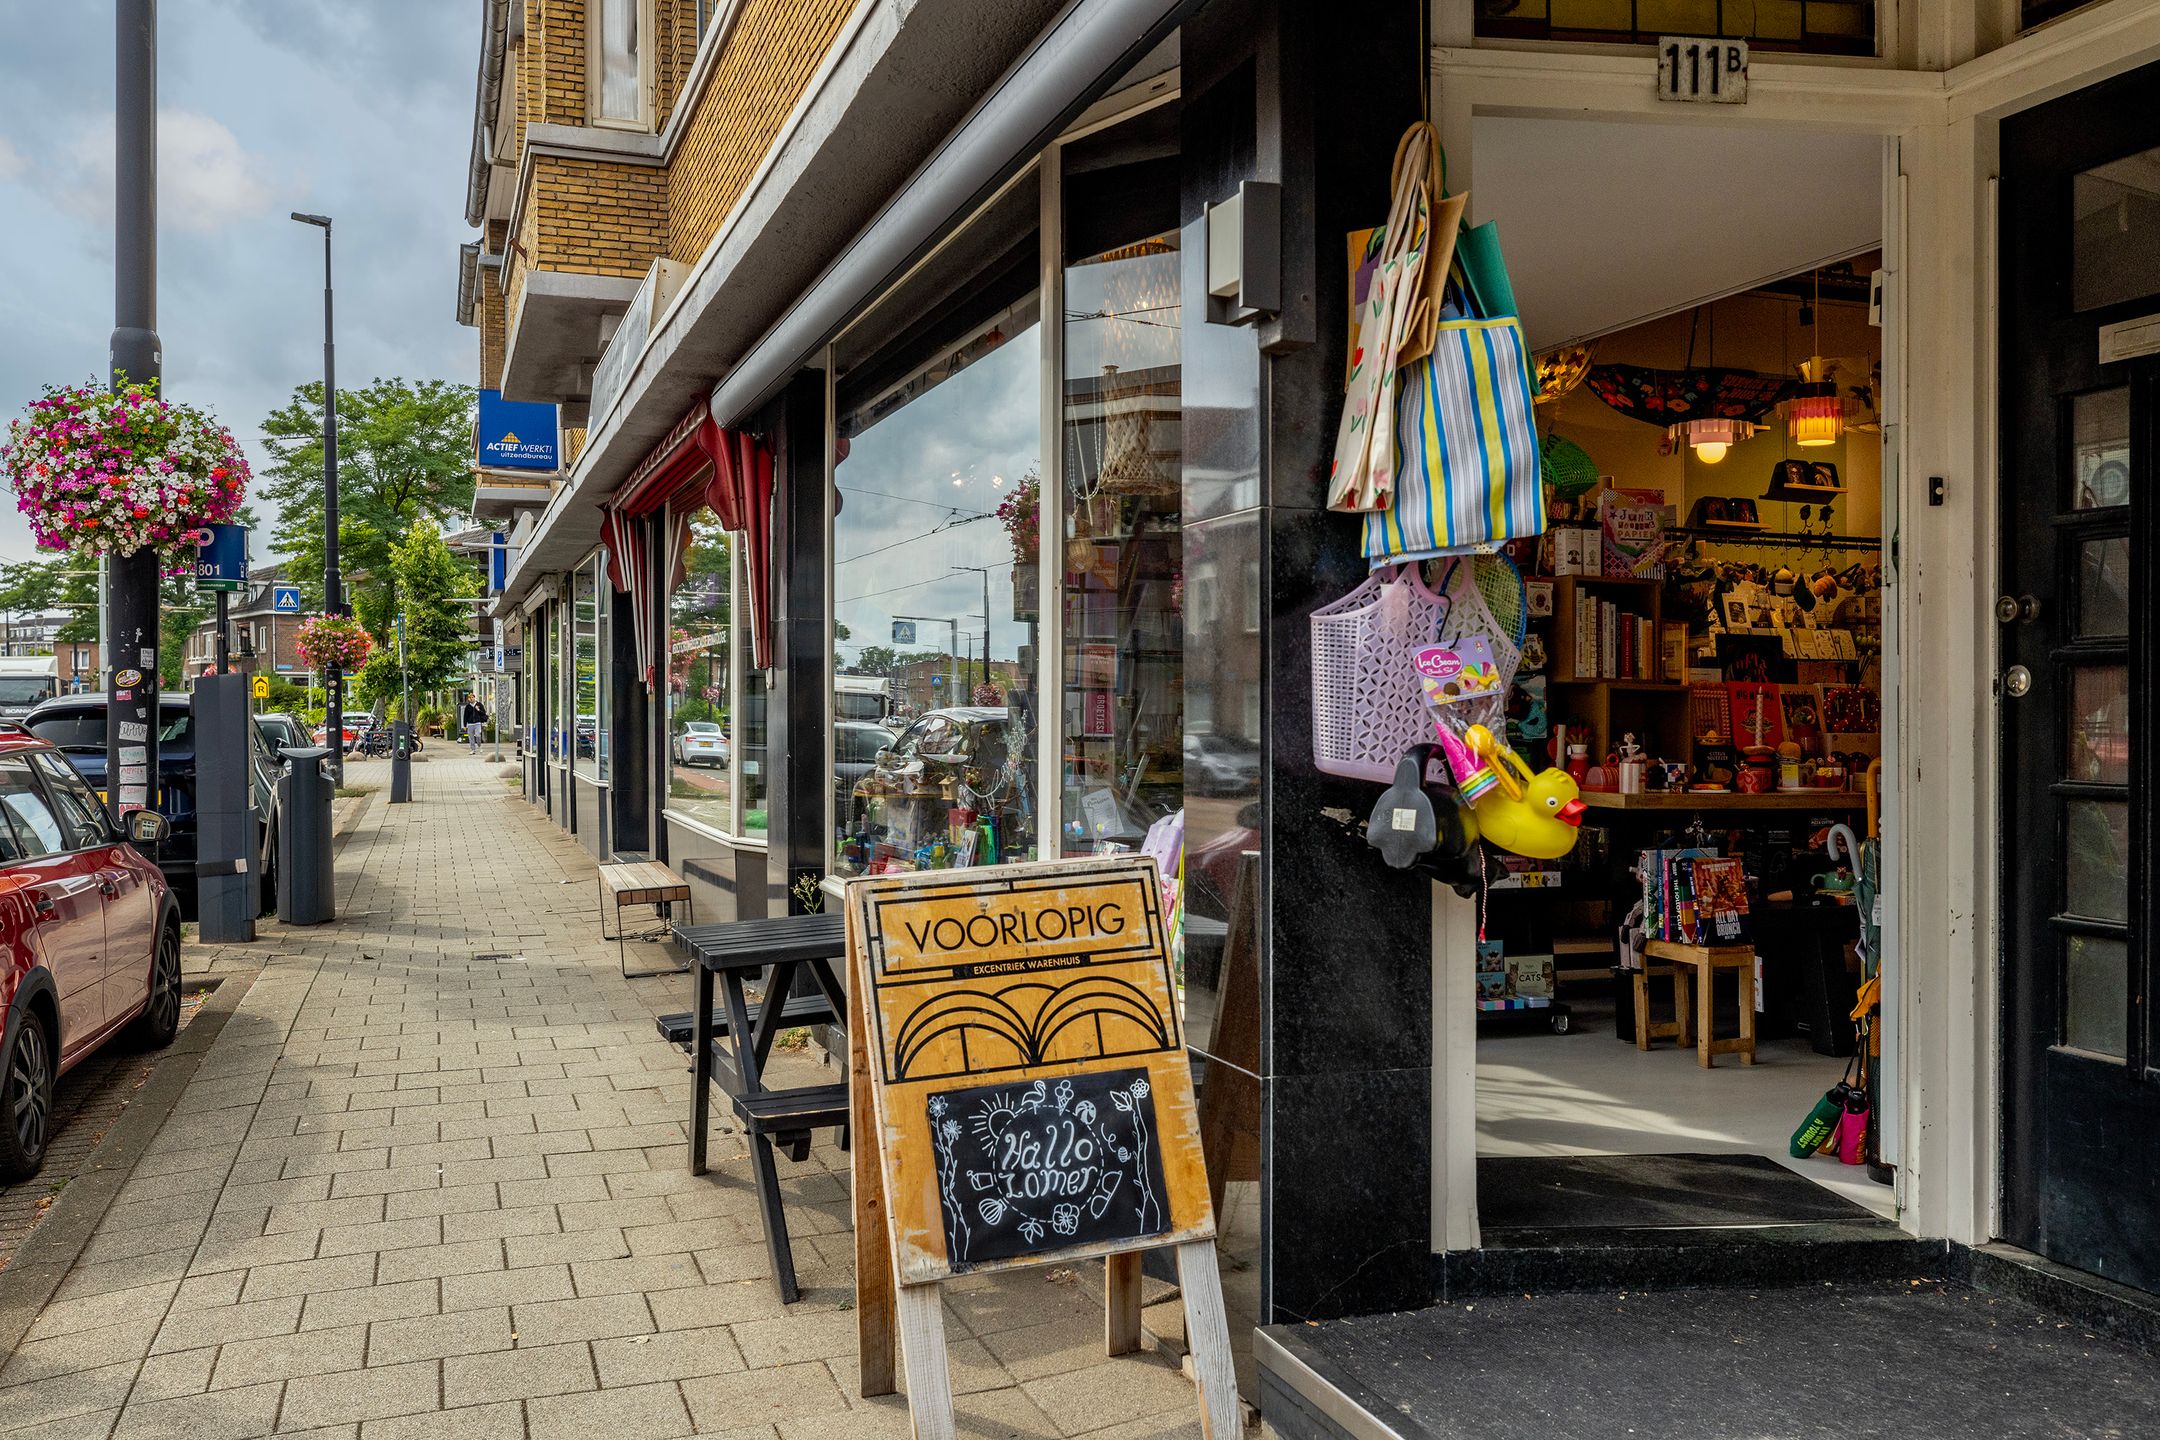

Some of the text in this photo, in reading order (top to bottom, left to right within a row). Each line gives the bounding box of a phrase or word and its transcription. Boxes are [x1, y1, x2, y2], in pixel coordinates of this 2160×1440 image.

[486, 442, 553, 454] ACTIEF WERKT!
[500, 452, 553, 460] uitzendbureau
[198, 563, 220, 576] 801
[257, 685, 265, 693] R
[1715, 910, 1739, 924] ALL DAY
[905, 903, 1125, 954] VOORLOPIG
[1716, 922, 1741, 936] BRUNCH
[973, 955, 1081, 975] EXCENTRIEK WARENHUIS
[1519, 974, 1541, 982] CATS
[1001, 1120, 1094, 1170] Hallo
